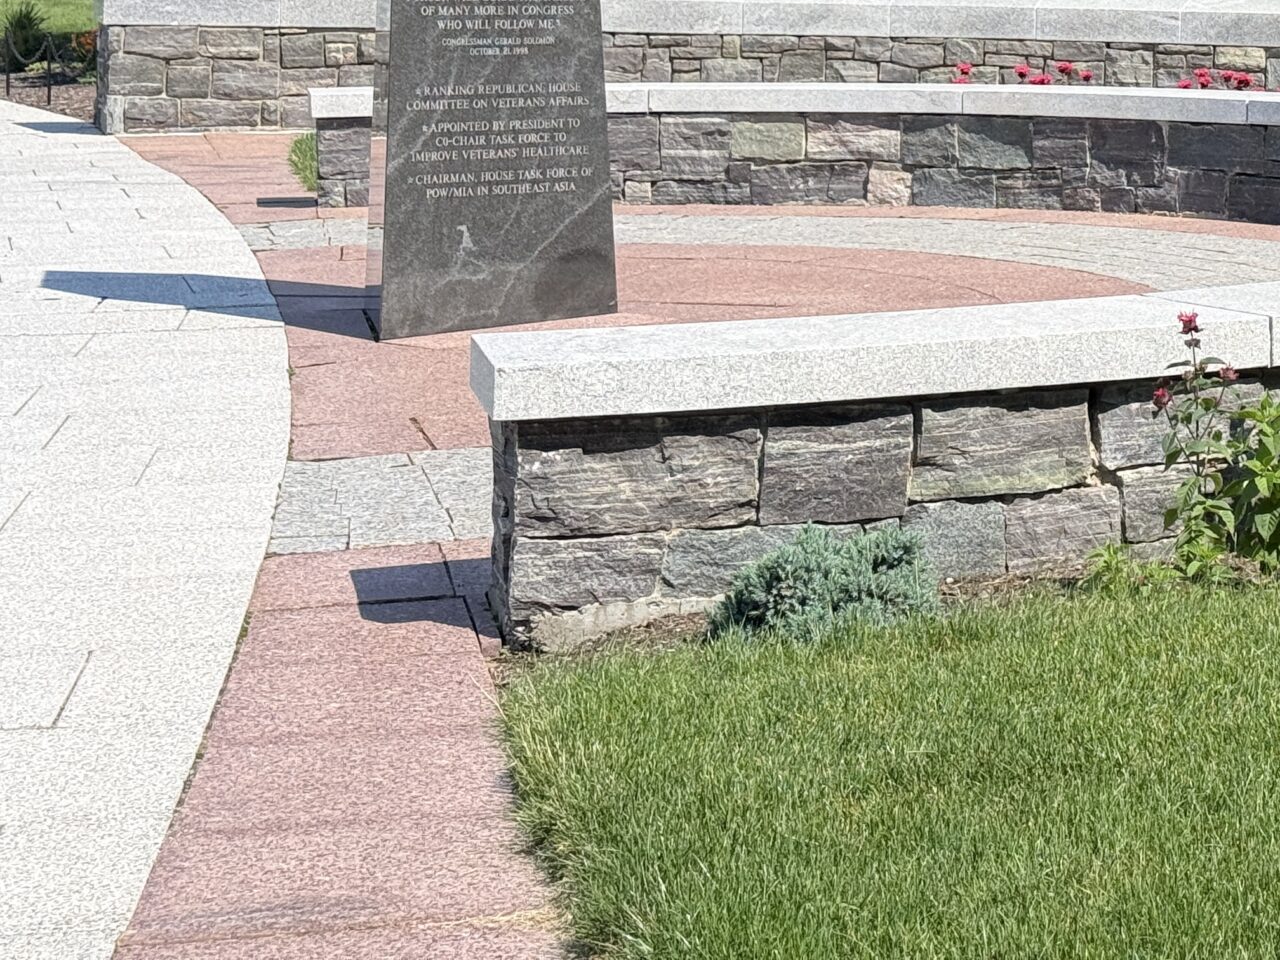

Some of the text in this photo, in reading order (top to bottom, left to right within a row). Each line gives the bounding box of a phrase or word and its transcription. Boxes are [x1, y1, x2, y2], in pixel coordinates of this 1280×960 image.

[421, 6, 574, 15] OF MANY MORE IN CONGRESS
[437, 20, 462, 29] WHO
[465, 20, 491, 29] WILL
[495, 19, 536, 28] FOLLOW
[442, 38, 491, 46] CONGRESSMAN
[524, 37, 555, 45] SOLOMON
[424, 85, 474, 96] RANKING
[549, 82, 581, 92] HOUSE
[406, 96, 589, 110] COMMITTEE ON VETERANS AFFAIRS
[429, 119, 580, 132] APPOINTED BY PRESIDENT TO
[436, 133, 566, 147] CO-CHAIR TASK FORCE TO
[411, 151, 458, 161] IMPROVE
[522, 146, 589, 157] HEALTHCARE
[481, 171, 515, 182] HOUSE
[518, 170, 543, 179] TASK
[546, 168, 578, 178] FORCE
[581, 168, 594, 176] OF
[426, 182, 575, 198] POW/MIA IN SOUTHEAST ASIA
